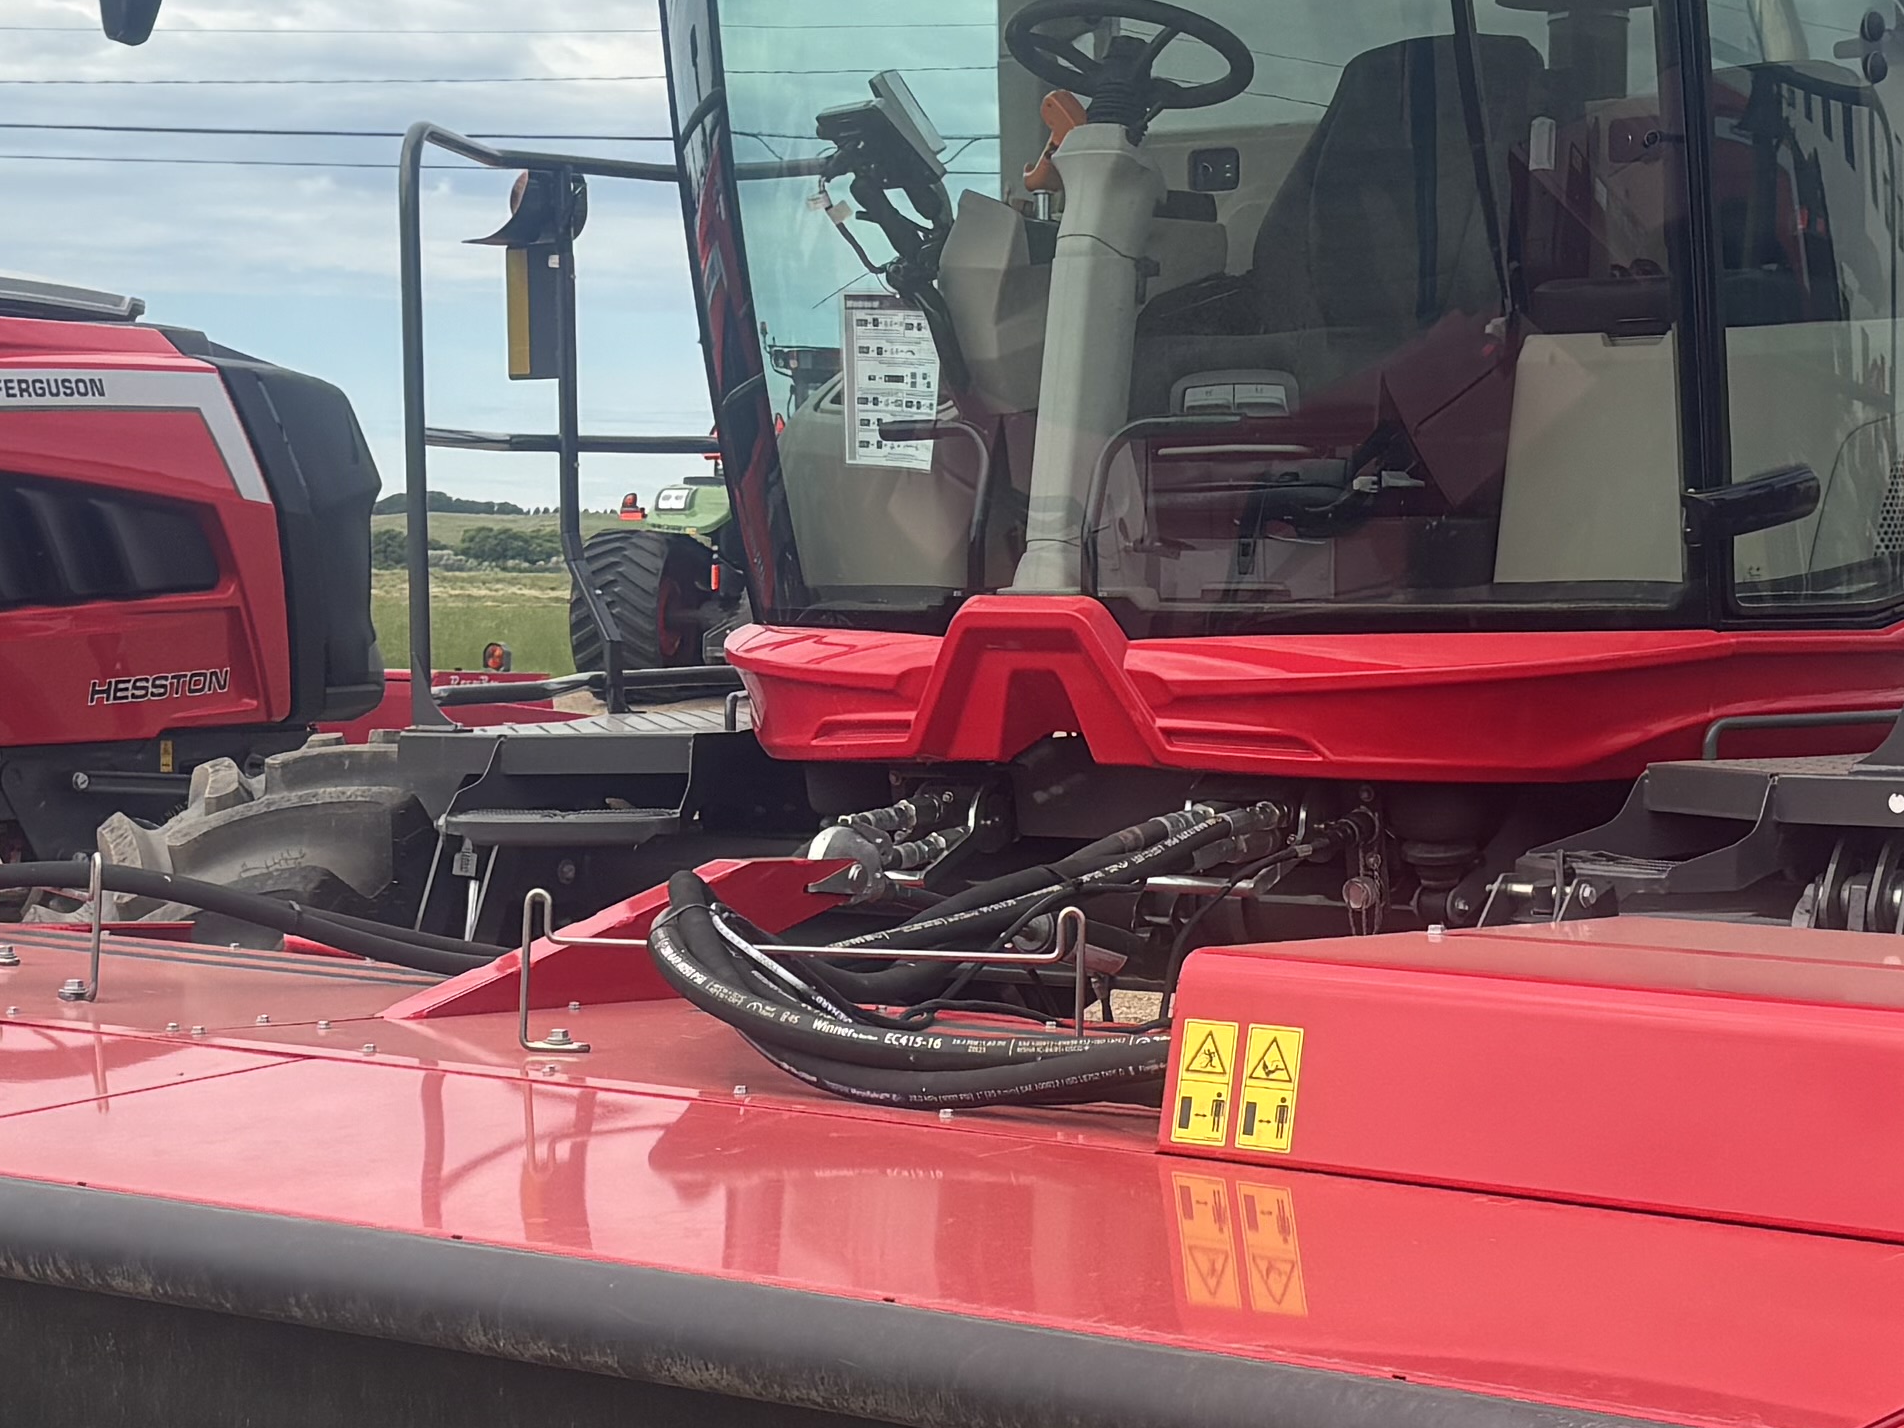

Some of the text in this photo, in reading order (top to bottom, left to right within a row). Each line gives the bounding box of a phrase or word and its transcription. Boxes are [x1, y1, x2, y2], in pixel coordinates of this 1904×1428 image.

[88, 667, 230, 706] HESSTON
[812, 1018, 854, 1038] Winner
[884, 1032, 942, 1049] EC415-16
